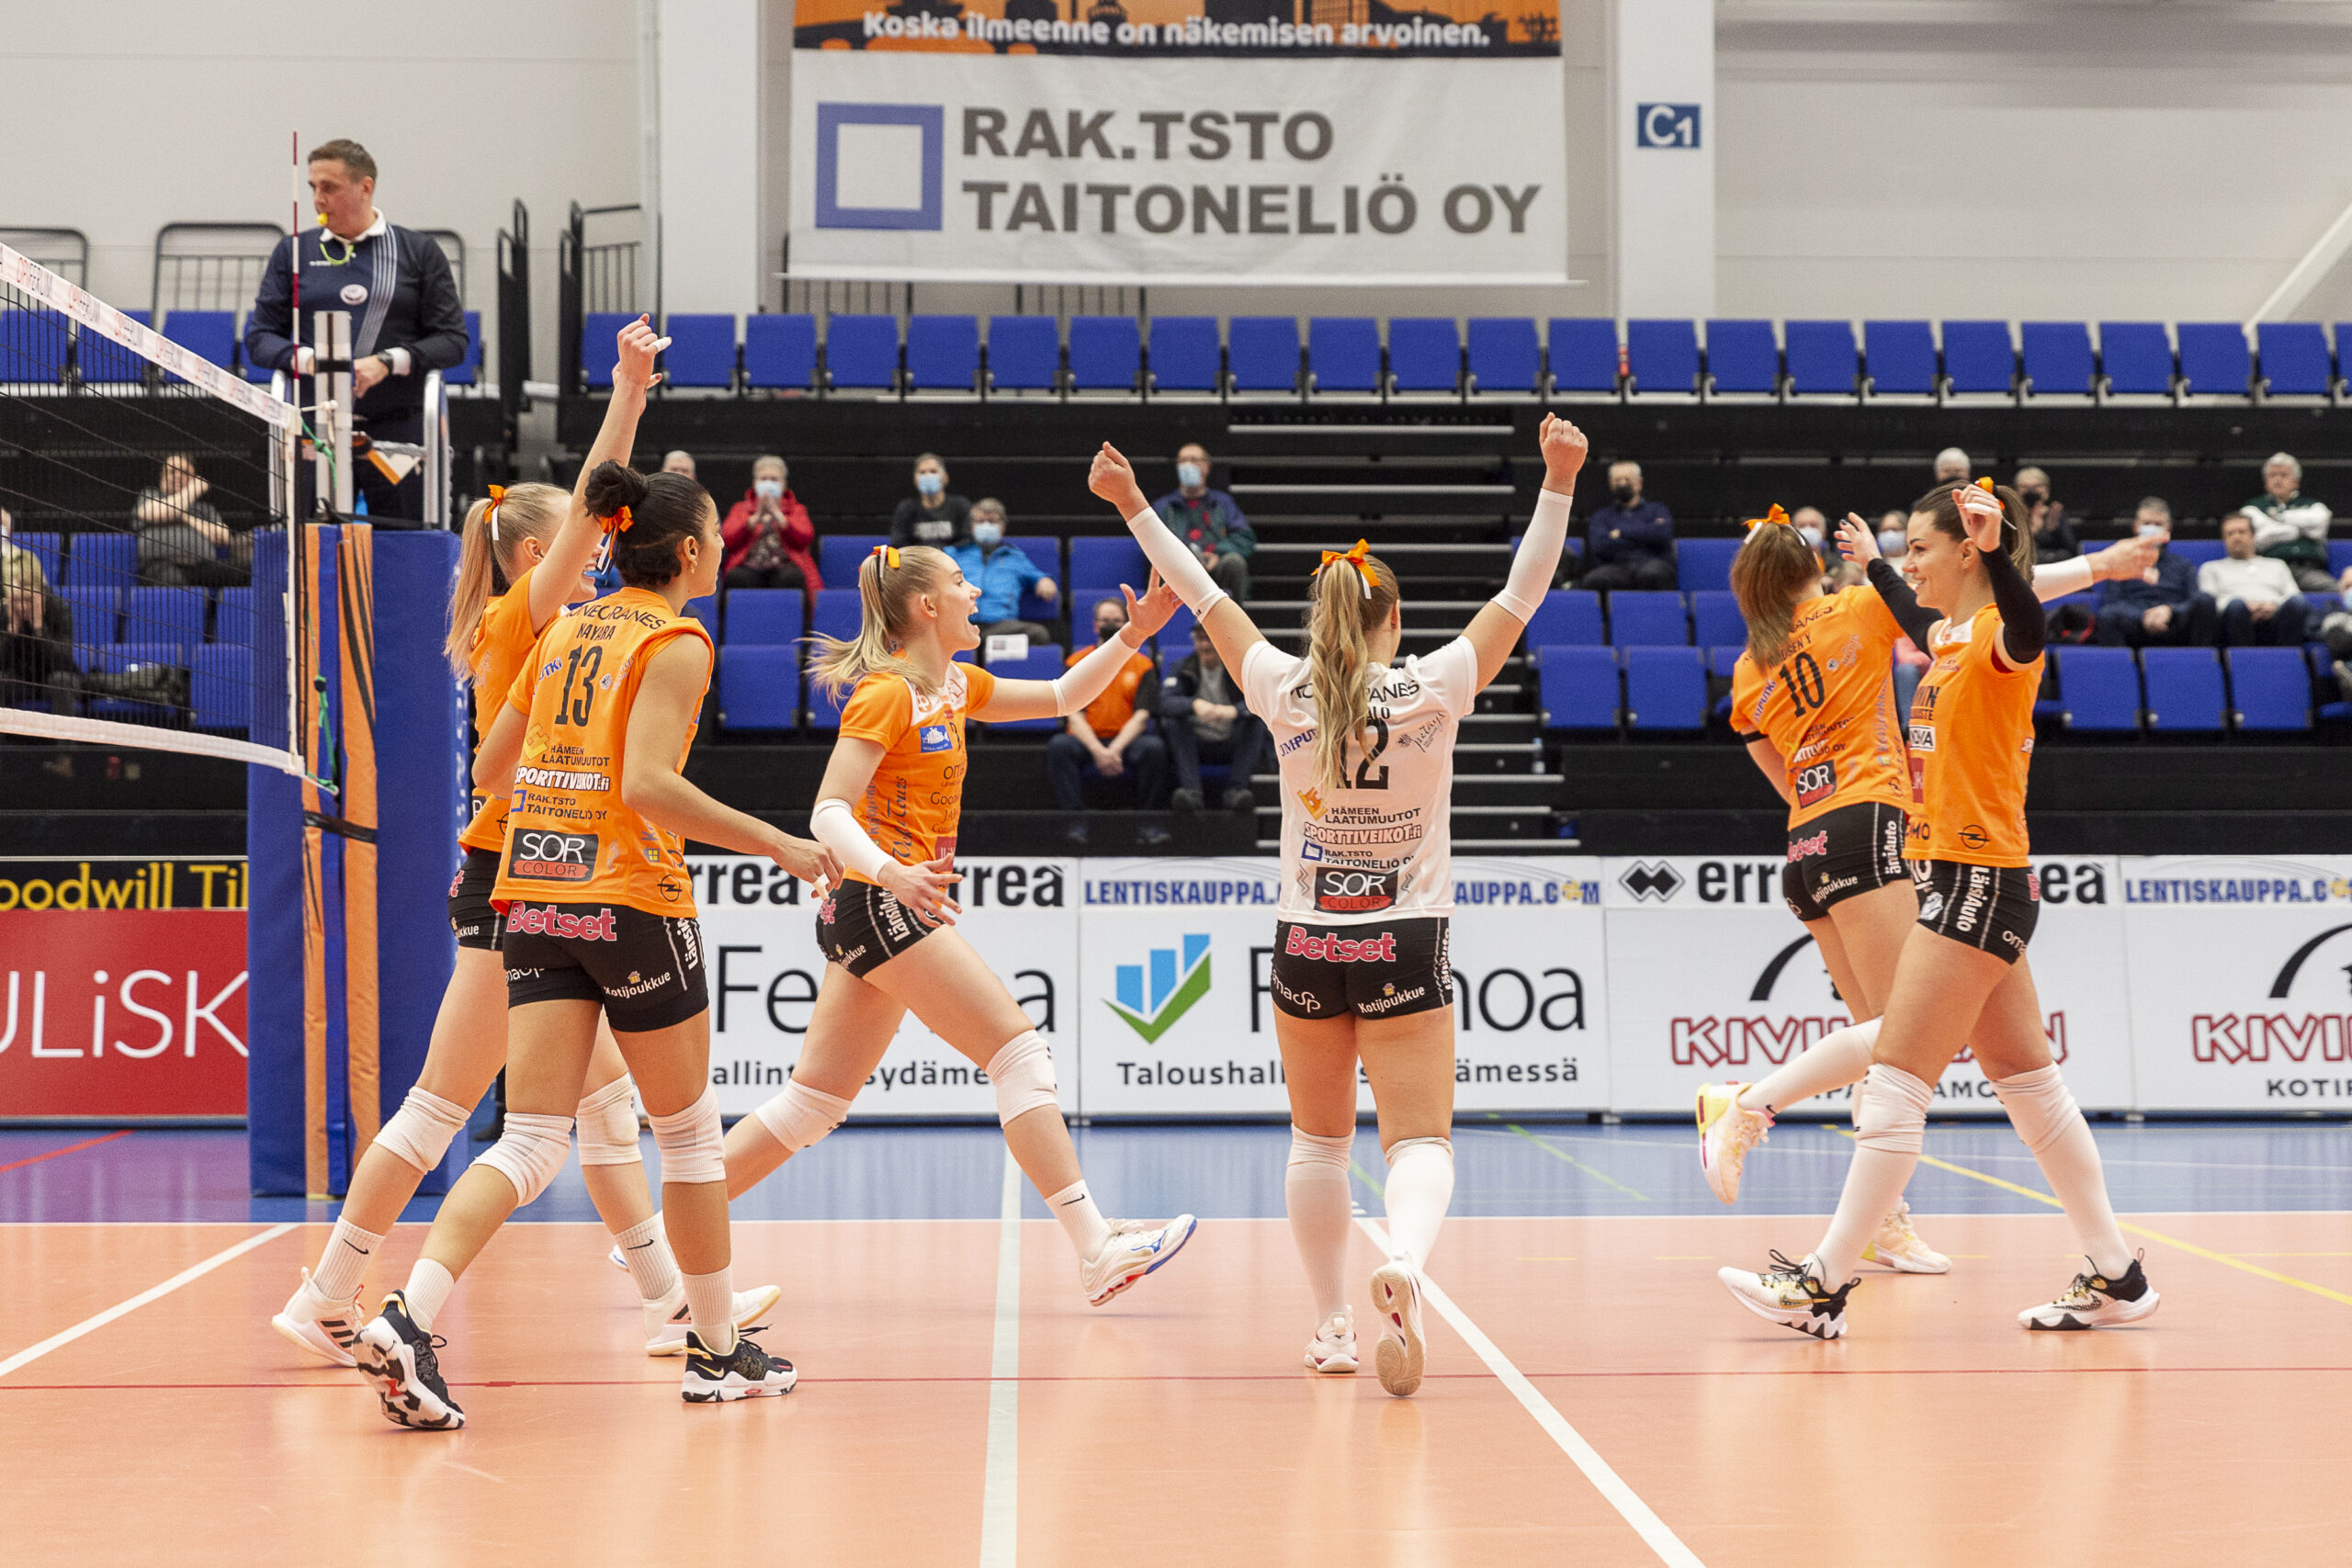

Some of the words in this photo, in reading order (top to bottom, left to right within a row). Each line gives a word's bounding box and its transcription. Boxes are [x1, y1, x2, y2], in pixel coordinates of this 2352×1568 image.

[863, 12, 959, 38] Koska
[966, 12, 1110, 43] ilmeenne
[1116, 22, 1158, 44] on
[1163, 16, 1333, 46] näkemisen
[1340, 17, 1490, 47] arvoinen.
[962, 107, 1333, 161] RAK.TSTO
[1643, 105, 1692, 146] C1
[962, 175, 1417, 234] TAITONELIÖ
[1442, 184, 1542, 234] OY
[576, 623, 616, 641] NAYARA
[555, 644, 603, 727] 13
[1779, 651, 1826, 717] 10
[1797, 765, 1830, 795] SOR
[527, 793, 576, 806] RAK.TSTO
[1331, 807, 1379, 815] HÄMEEN
[1325, 807, 1421, 824] LAATUMUUTOT
[520, 833, 585, 863] SOR
[1325, 849, 1373, 858] RAK.TSTO
[522, 861, 578, 876] COLOR
[1085, 881, 1281, 905] LENTISKAUPPA.
[1323, 872, 1387, 897] SOR
[1329, 897, 1382, 909] COLOR
[505, 901, 616, 942] Betset
[1285, 925, 1396, 962] Betset
[1358, 986, 1425, 1013] Kotijoukkue
[2193, 1013, 2352, 1064] KIVI
[1117, 1062, 1285, 1086] Taloushall
